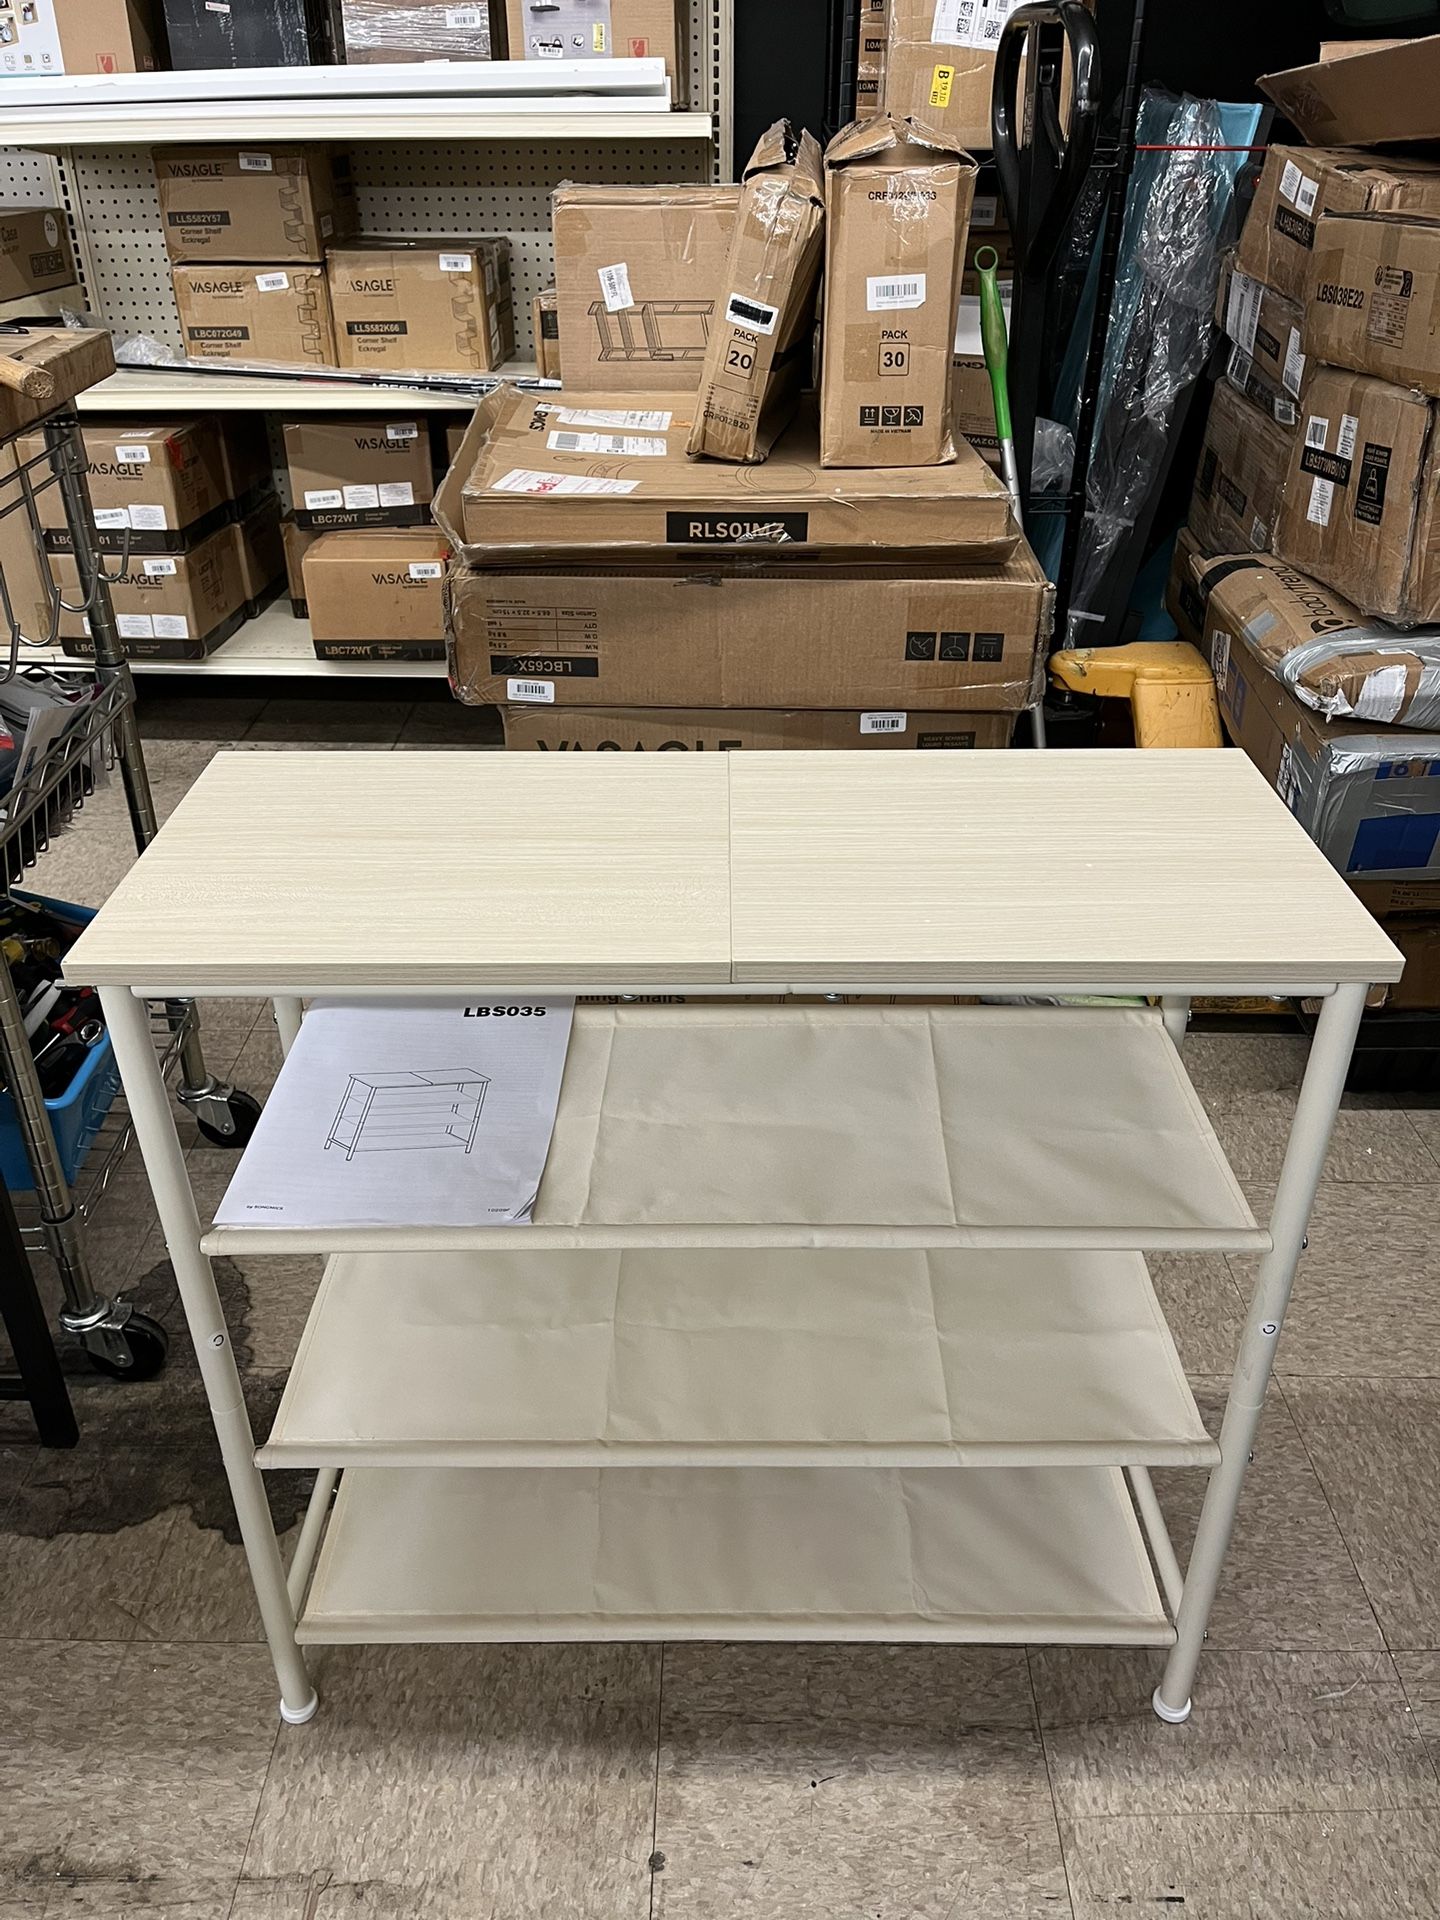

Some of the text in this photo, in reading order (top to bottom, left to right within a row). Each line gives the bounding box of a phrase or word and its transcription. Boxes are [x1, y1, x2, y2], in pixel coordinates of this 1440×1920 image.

[938, 70, 950, 79] B
[168, 163, 223, 176] VASAGLE
[205, 227, 222, 235] Shelf
[182, 236, 211, 244] Eckregal
[189, 281, 244, 293] VASAGLE
[346, 279, 393, 292] ASAGLE
[1316, 282, 1364, 309] LBS038E22
[357, 336, 397, 344] Corner Shelf
[733, 328, 759, 344] PACK
[881, 330, 908, 339] PACK
[224, 341, 242, 349] Shelf
[358, 345, 387, 353] Eckregal
[728, 350, 752, 370] 20
[883, 351, 905, 367] 30
[354, 438, 410, 449] VASAGLE
[312, 513, 359, 525] LBC72WT
[325, 646, 371, 655] LBC72WT
[519, 660, 572, 673] LBC65X
[463, 1006, 547, 1018] LBS035
